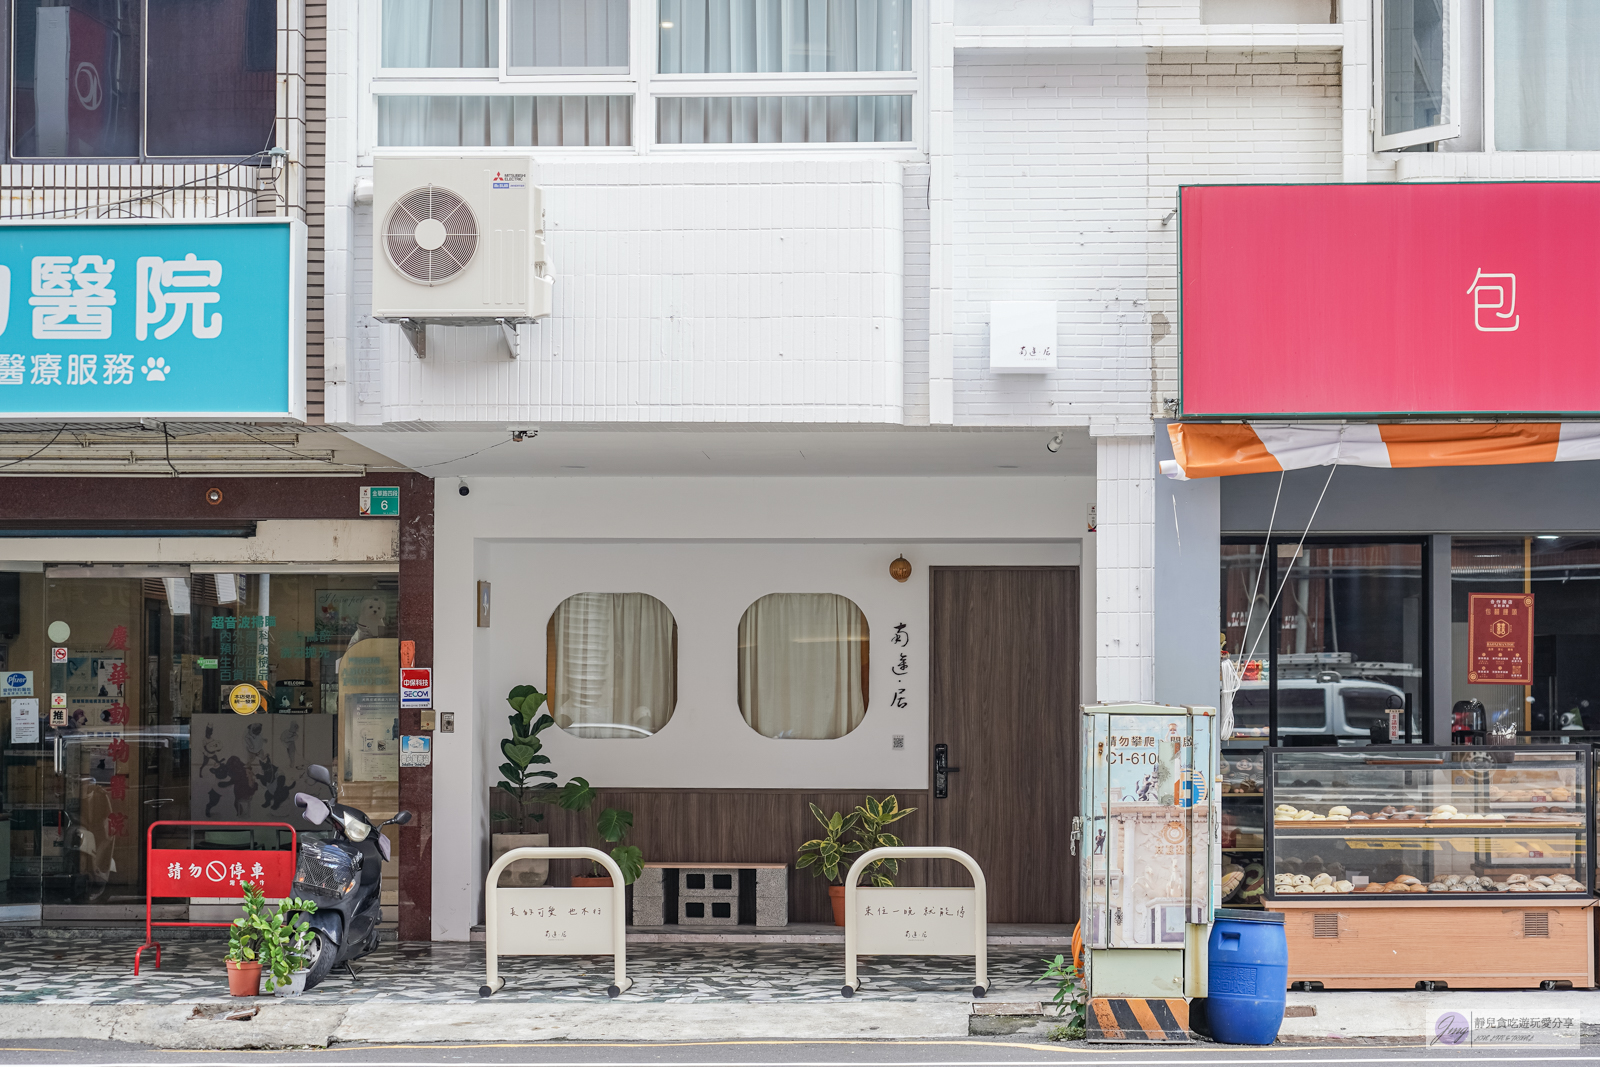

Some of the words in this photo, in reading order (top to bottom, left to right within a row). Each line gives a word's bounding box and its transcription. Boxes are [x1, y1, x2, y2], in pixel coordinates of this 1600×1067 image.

[0, 253, 223, 341] 醫院
[1466, 267, 1520, 332] 包
[0, 353, 135, 386] 醫療服務
[380, 500, 388, 510] 6
[211, 616, 277, 629] 超音波掃瞄
[220, 643, 269, 656] 預防注射
[8, 674, 27, 686] Pfizer
[220, 668, 269, 680] 百貨用品
[53, 710, 64, 720] 推
[106, 625, 131, 837] 慶華動物醫院
[1106, 752, 1160, 765] C1-610
